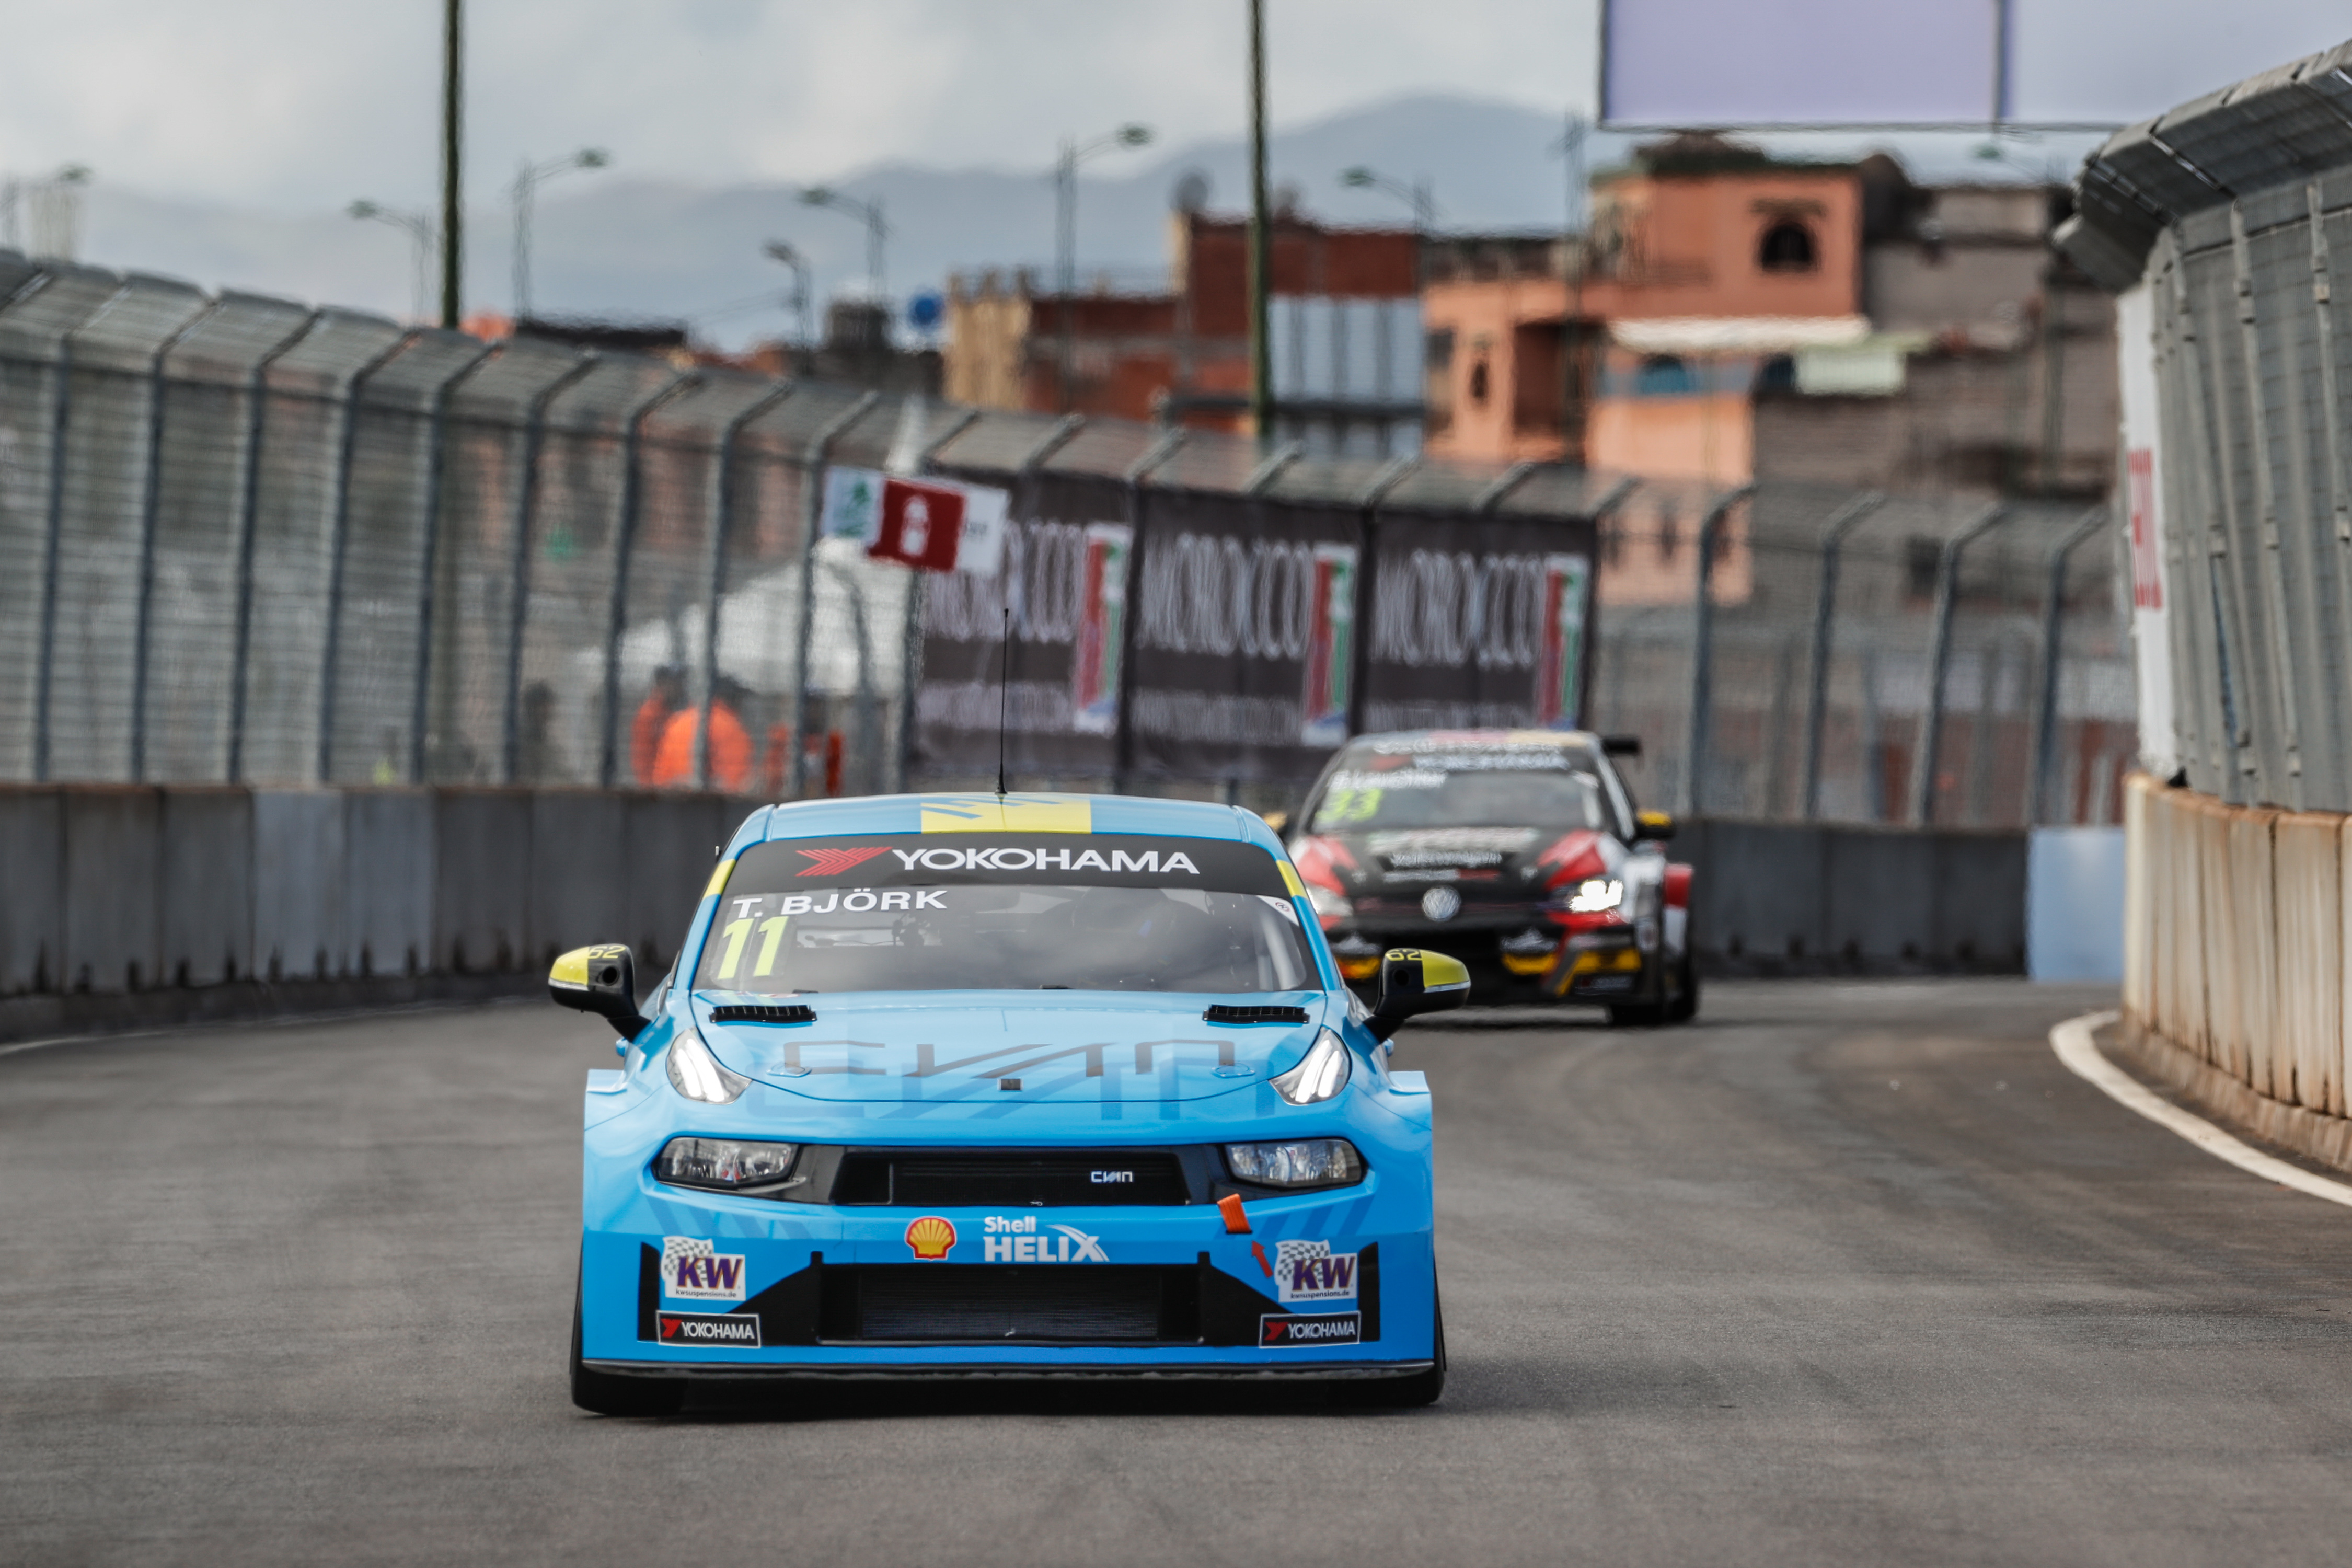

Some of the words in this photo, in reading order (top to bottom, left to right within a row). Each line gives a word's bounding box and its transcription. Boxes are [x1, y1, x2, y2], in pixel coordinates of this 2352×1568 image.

[892, 848, 1200, 874] YOKOHAMA
[733, 897, 763, 918] T.
[780, 888, 948, 915] BJÖRK
[587, 945, 626, 960] 62
[717, 916, 790, 980] 11
[1385, 949, 1423, 961] 62
[984, 1216, 1037, 1233] Shell
[983, 1224, 1110, 1263] HELIX
[677, 1255, 743, 1290] KW
[1292, 1256, 1356, 1291] KW
[675, 1288, 737, 1298] kwsuspensions.de
[681, 1321, 755, 1340] YOKOHAMA
[1287, 1320, 1356, 1339] YOKOHAMA
